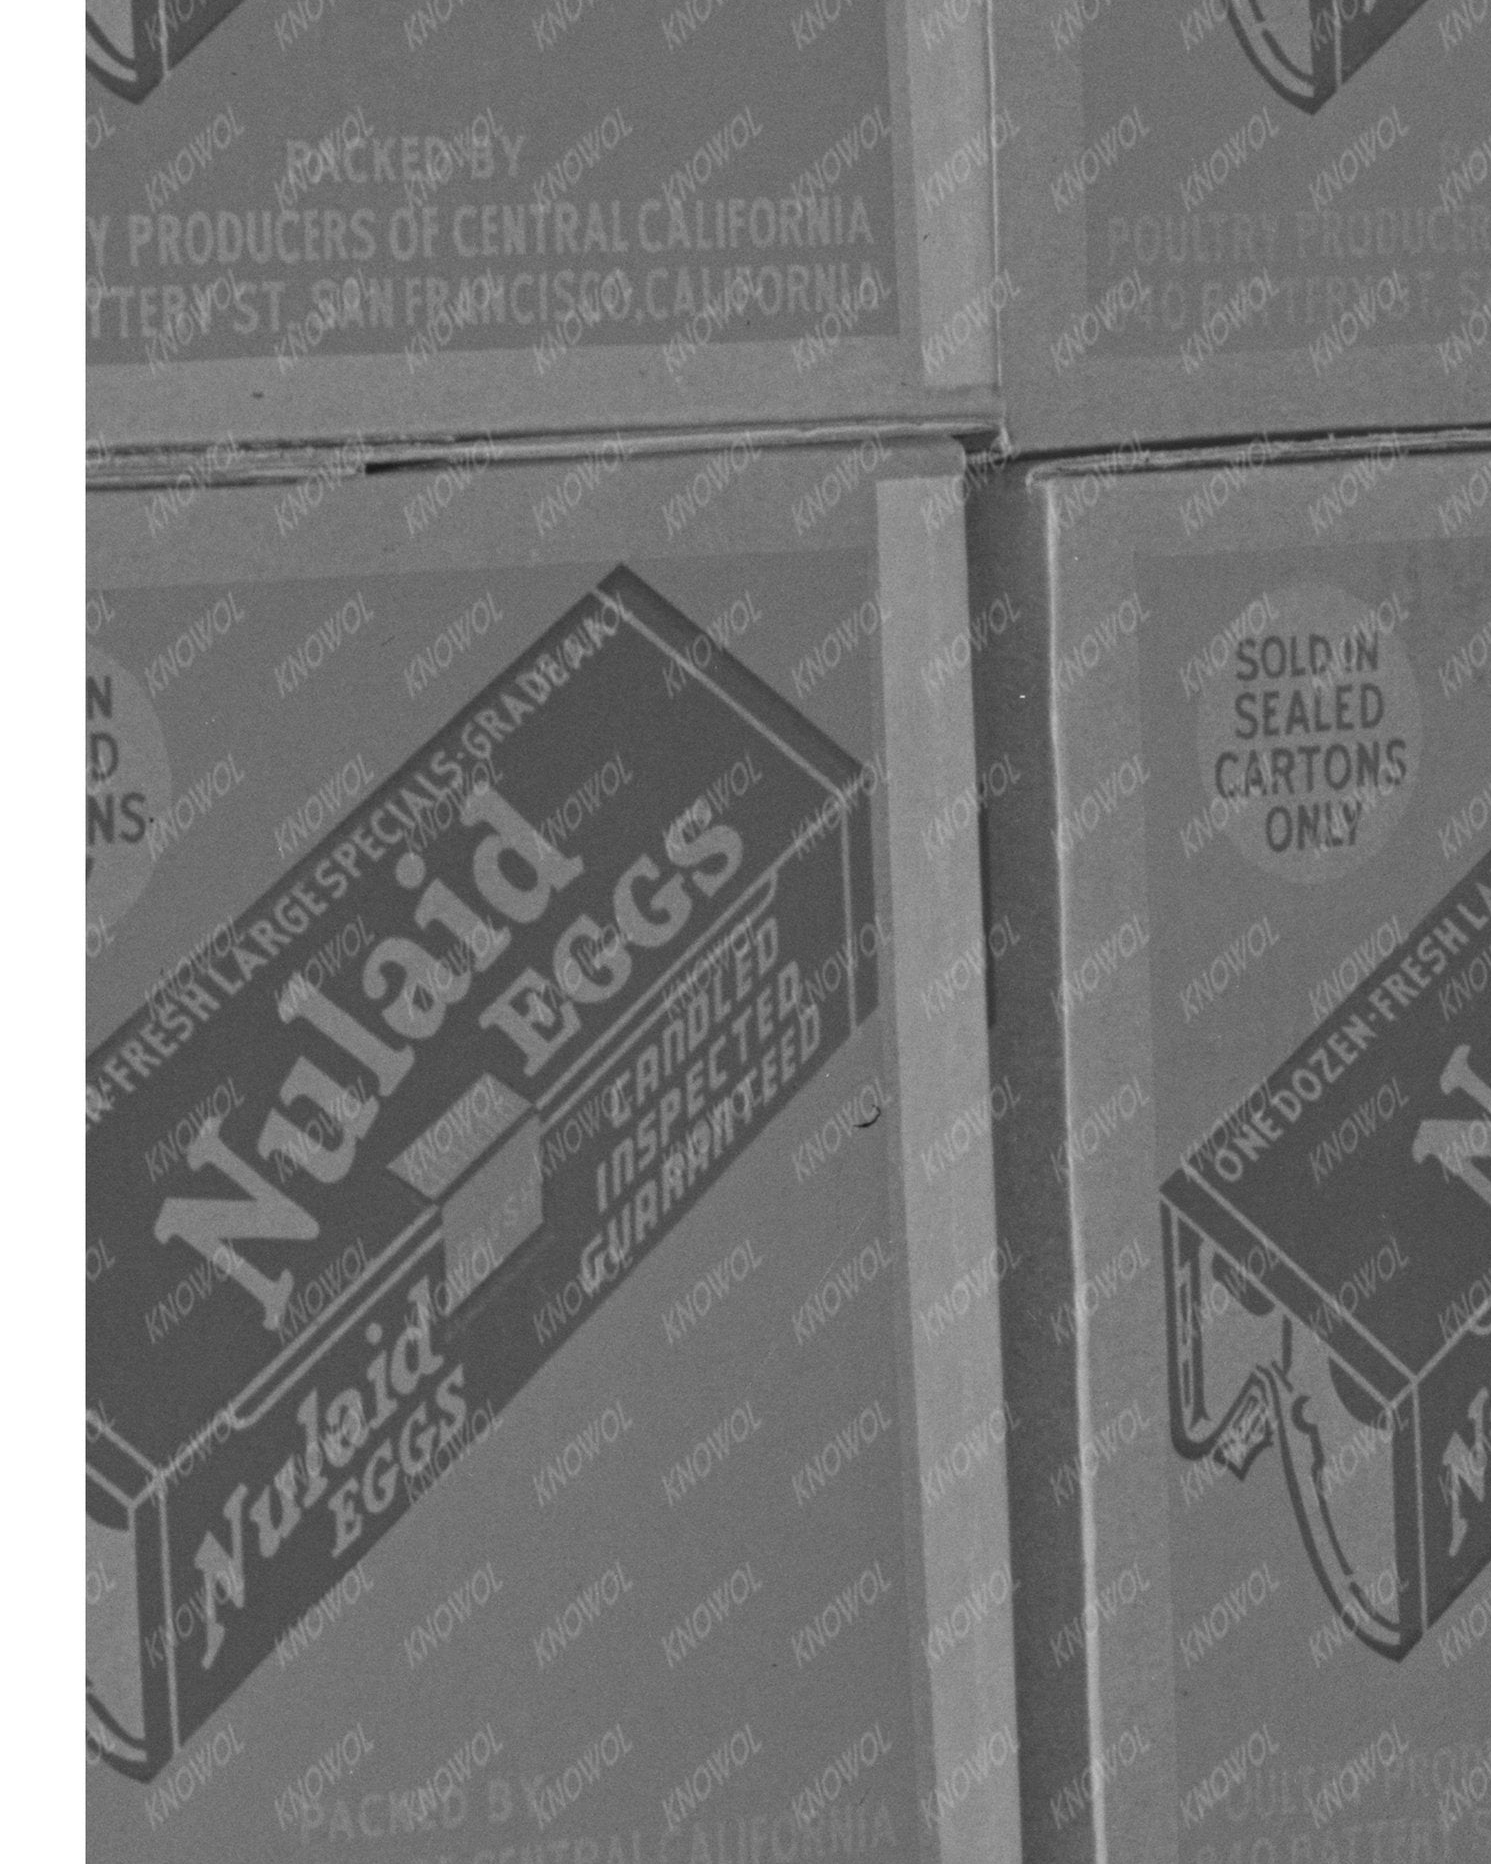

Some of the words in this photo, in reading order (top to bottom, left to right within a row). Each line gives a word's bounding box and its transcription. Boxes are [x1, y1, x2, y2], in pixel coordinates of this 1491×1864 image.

[285, 139, 451, 186] PACKED
[470, 135, 524, 179] BY
[128, 209, 375, 268] PRODUCERS
[389, 206, 442, 261] OF
[453, 200, 628, 261] CENTRAL
[639, 195, 875, 255] CALIFORNIA
[1233, 635, 1333, 683] SOLD
[1344, 631, 1379, 674] IN
[1232, 682, 1386, 741] SEALED
[1213, 738, 1409, 800] CARTONS
[109, 973, 222, 1096] FRESH
[208, 882, 327, 998] LARGE
[322, 750, 464, 897] SPECIALS
[464, 652, 568, 758] GRADE
[562, 611, 615, 665] AA
[1264, 800, 1364, 855] ONLY
[478, 801, 741, 1076] EGGS
[154, 782, 585, 1328] Nulaid
[198, 1279, 444, 1666] Nulaid
[332, 1368, 468, 1556] EGGS
